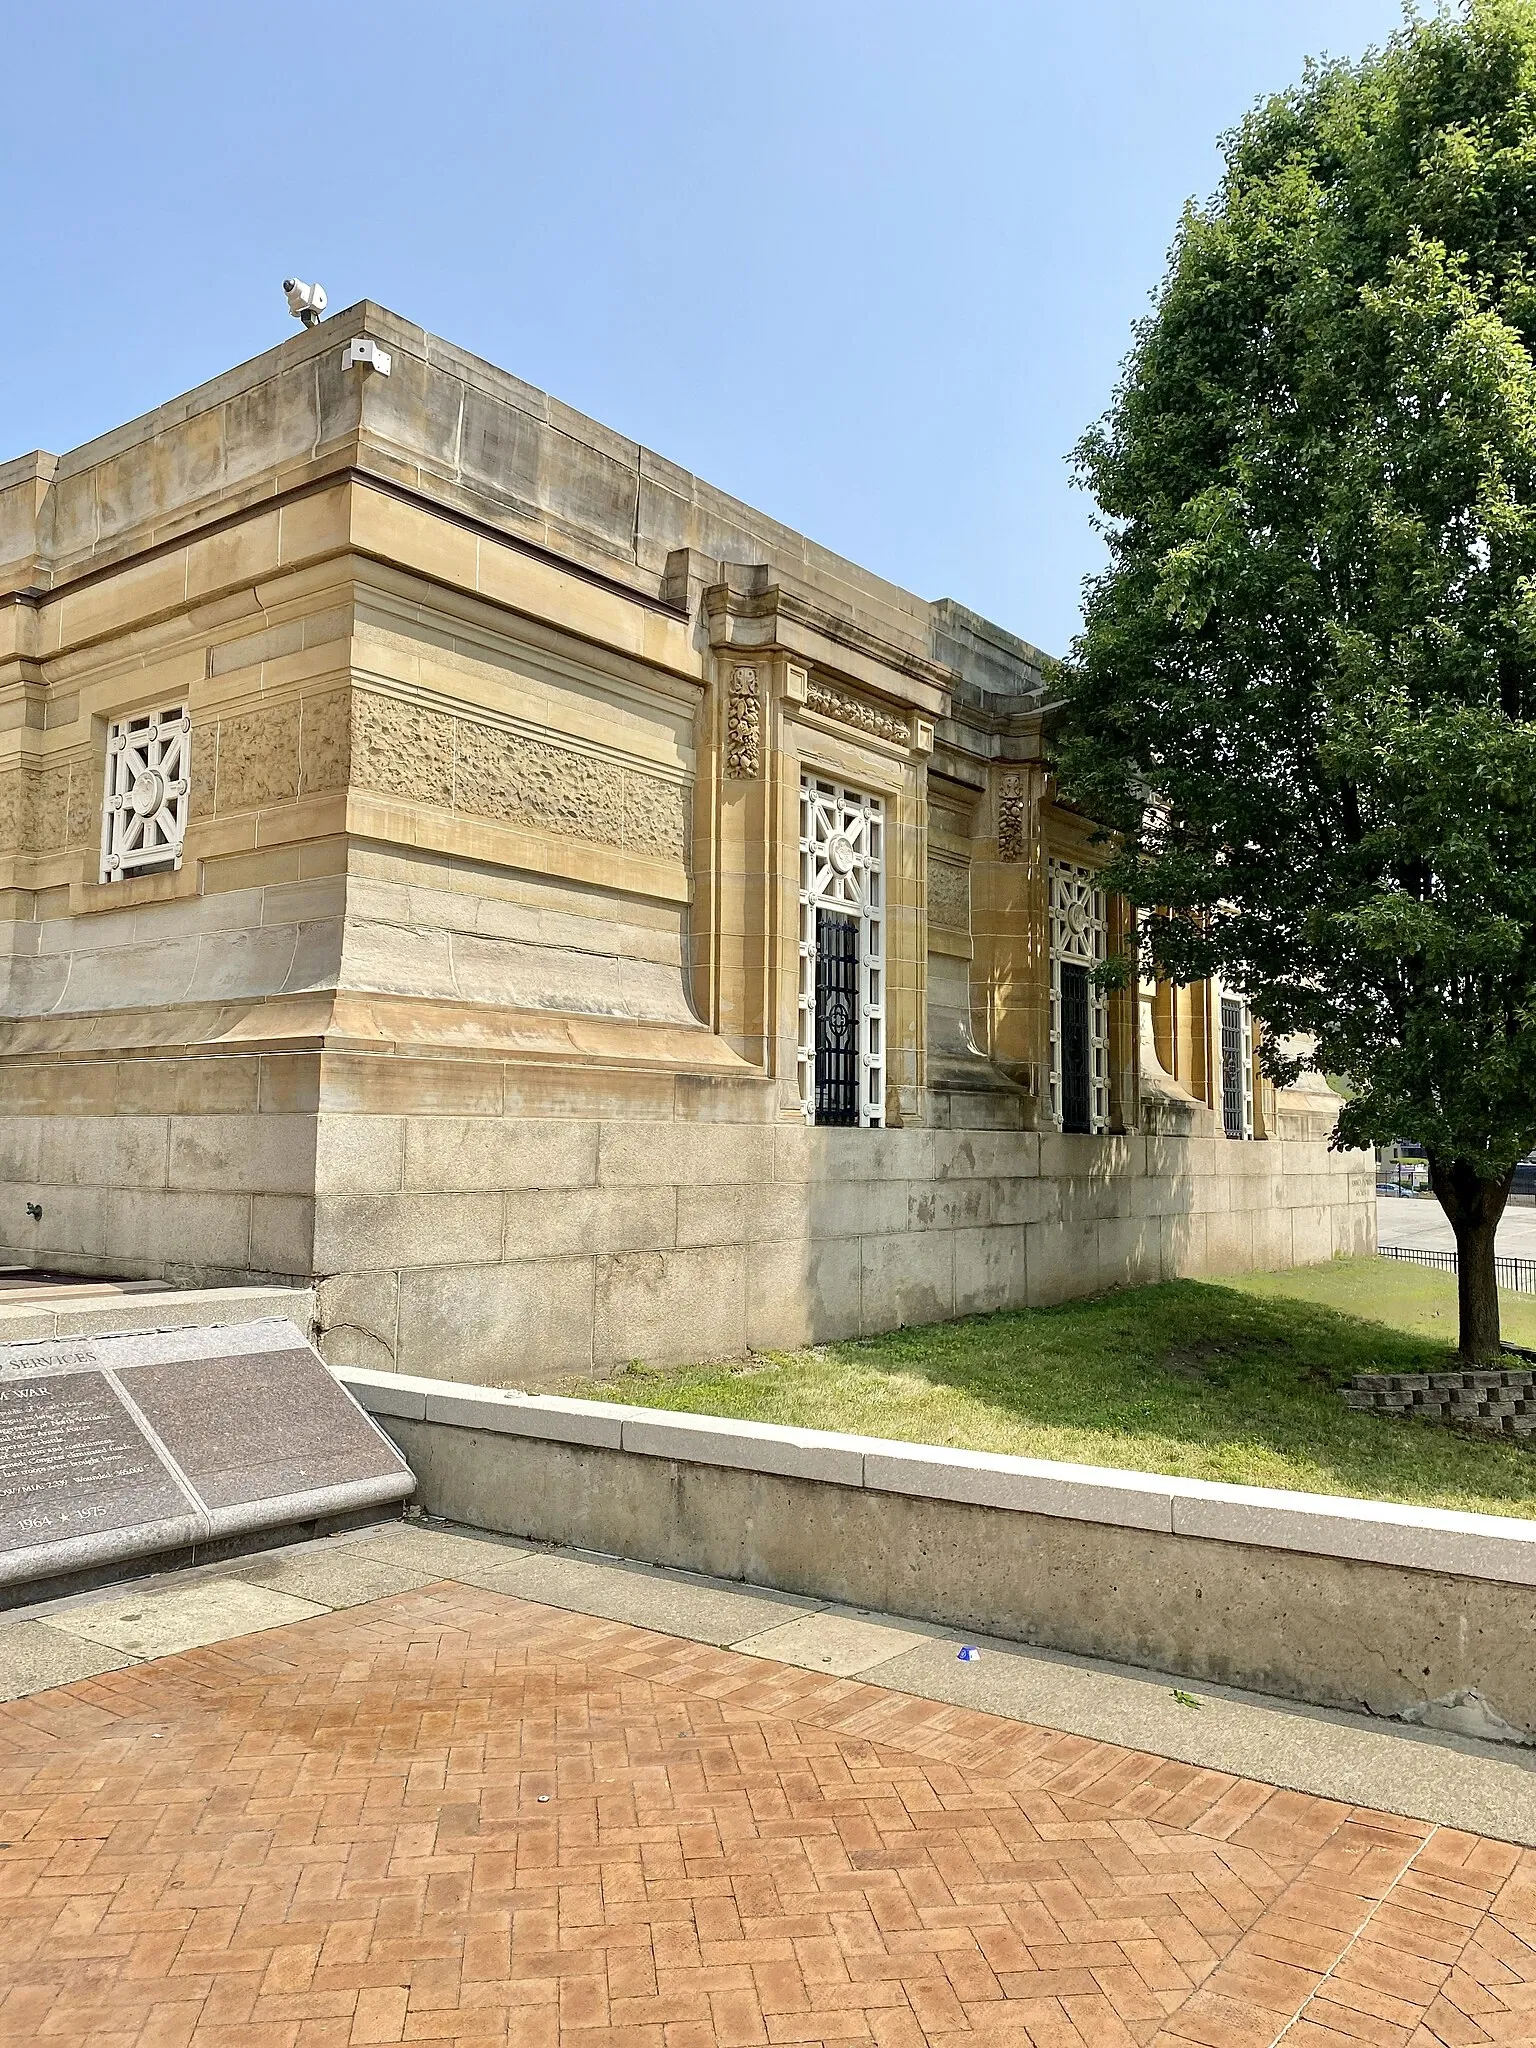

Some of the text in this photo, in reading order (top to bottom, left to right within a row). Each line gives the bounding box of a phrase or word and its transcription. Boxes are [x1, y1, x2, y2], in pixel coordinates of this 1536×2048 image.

[10, 1351, 97, 1370] SERVICES
[9, 1387, 52, 1399] WAR
[12, 1432, 34, 1440] other
[37, 1428, 64, 1438] Armed
[66, 1425, 91, 1433] Forces
[39, 1420, 48, 1430] of
[0, 1452, 9, 1460] of
[47, 1444, 62, 1453] and
[28, 1454, 65, 1465] Congress
[66, 1447, 107, 1459] eliminated
[2, 1469, 20, 1478] last
[20, 1466, 46, 1475] troops
[47, 1462, 68, 1471] were
[69, 1457, 101, 1467] brought
[15, 1505, 108, 1531] 1964 1975
